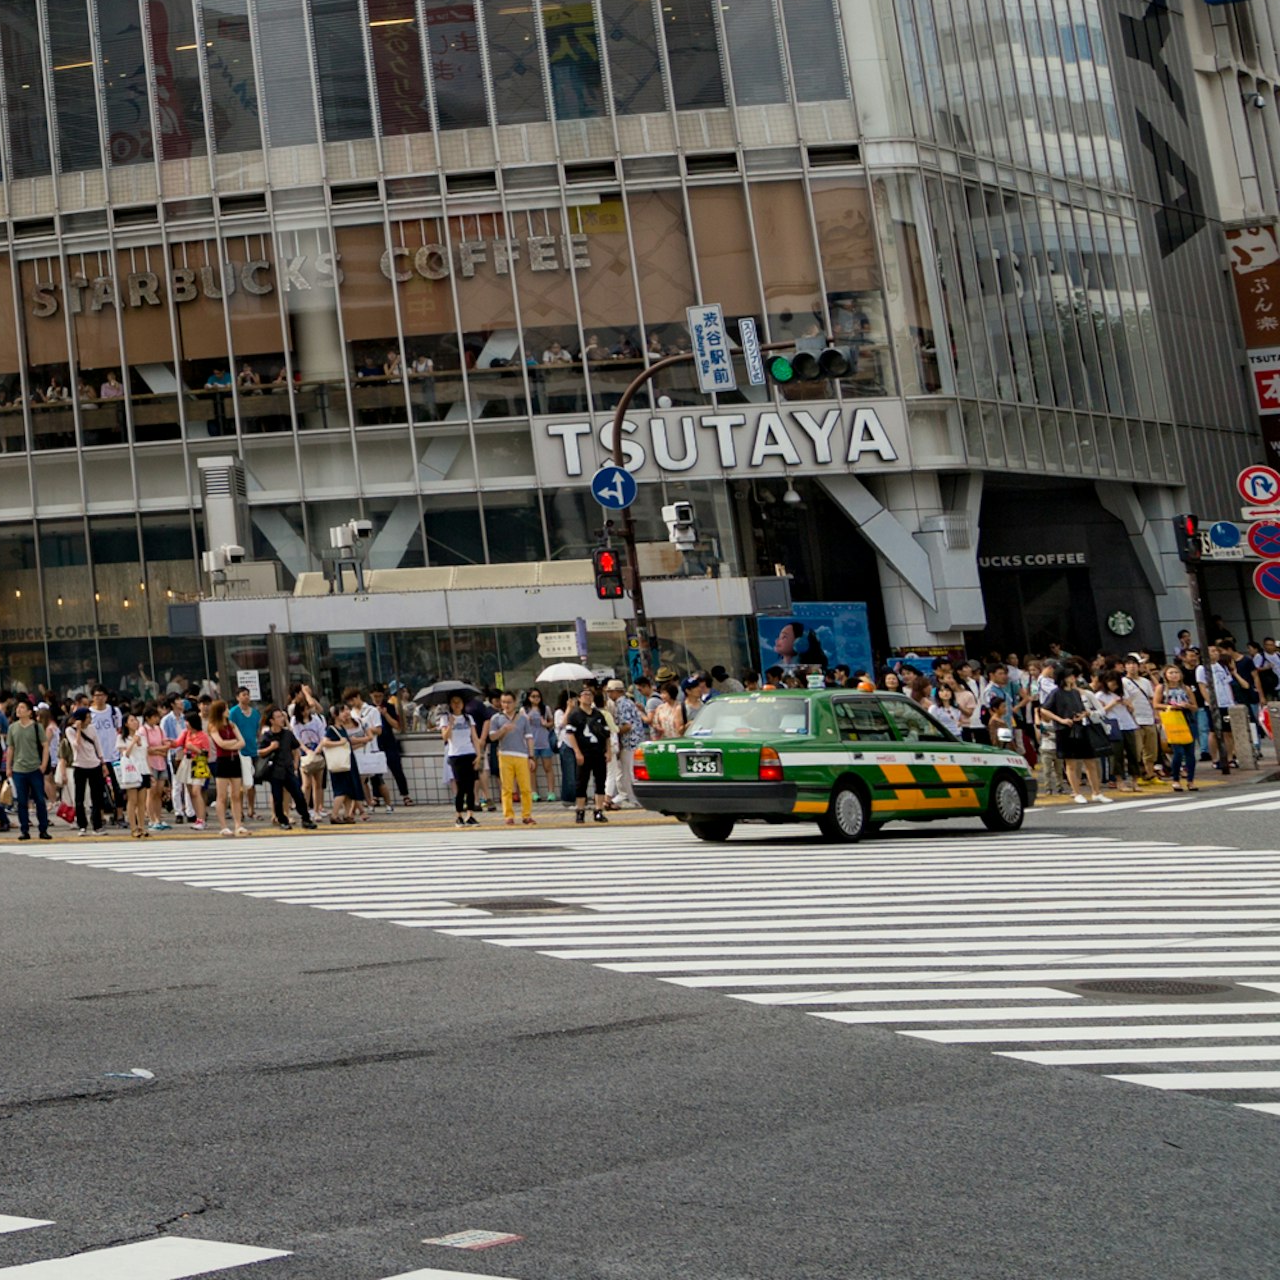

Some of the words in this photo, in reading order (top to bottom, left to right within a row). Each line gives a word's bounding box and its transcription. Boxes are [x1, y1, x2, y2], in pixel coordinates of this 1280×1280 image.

[32, 250, 343, 318] STARBUCKS
[380, 233, 591, 282] COFFEE
[703, 312, 729, 384] 渋谷駅前
[547, 408, 898, 476] TSUTAYA
[1024, 553, 1086, 565] COFFEE
[55, 624, 119, 638] COFFEE
[692, 762, 717, 772] 69-65
